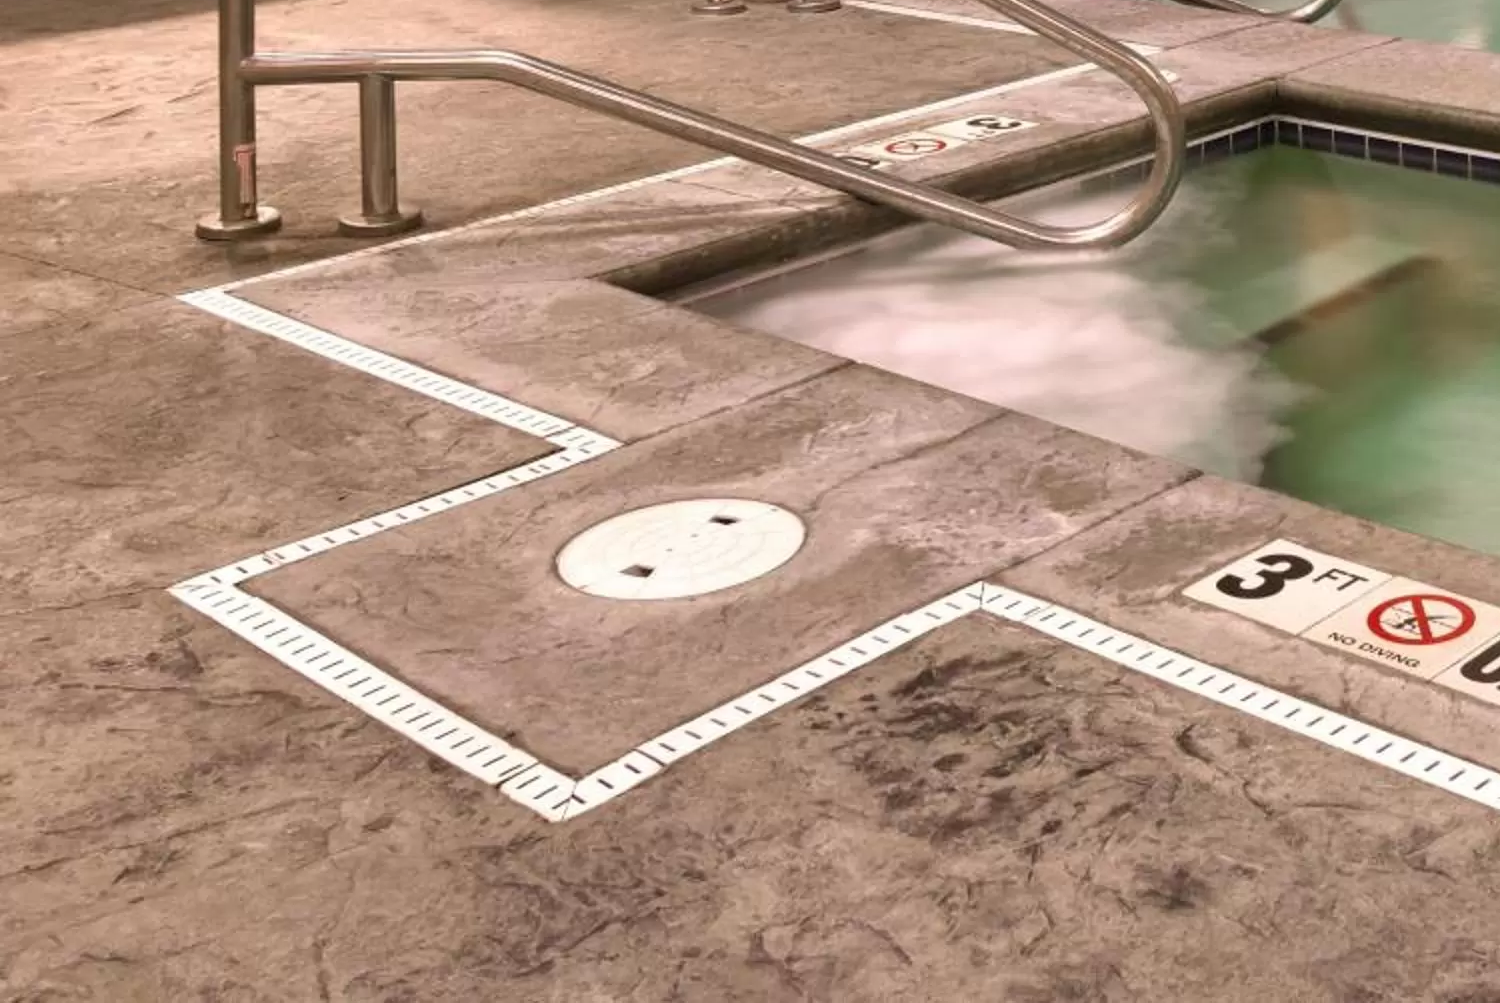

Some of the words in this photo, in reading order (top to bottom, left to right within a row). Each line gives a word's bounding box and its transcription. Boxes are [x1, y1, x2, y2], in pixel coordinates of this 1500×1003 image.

[1215, 553, 1314, 599] 3
[1327, 631, 1357, 646] NO
[1357, 642, 1421, 668] DIVING
